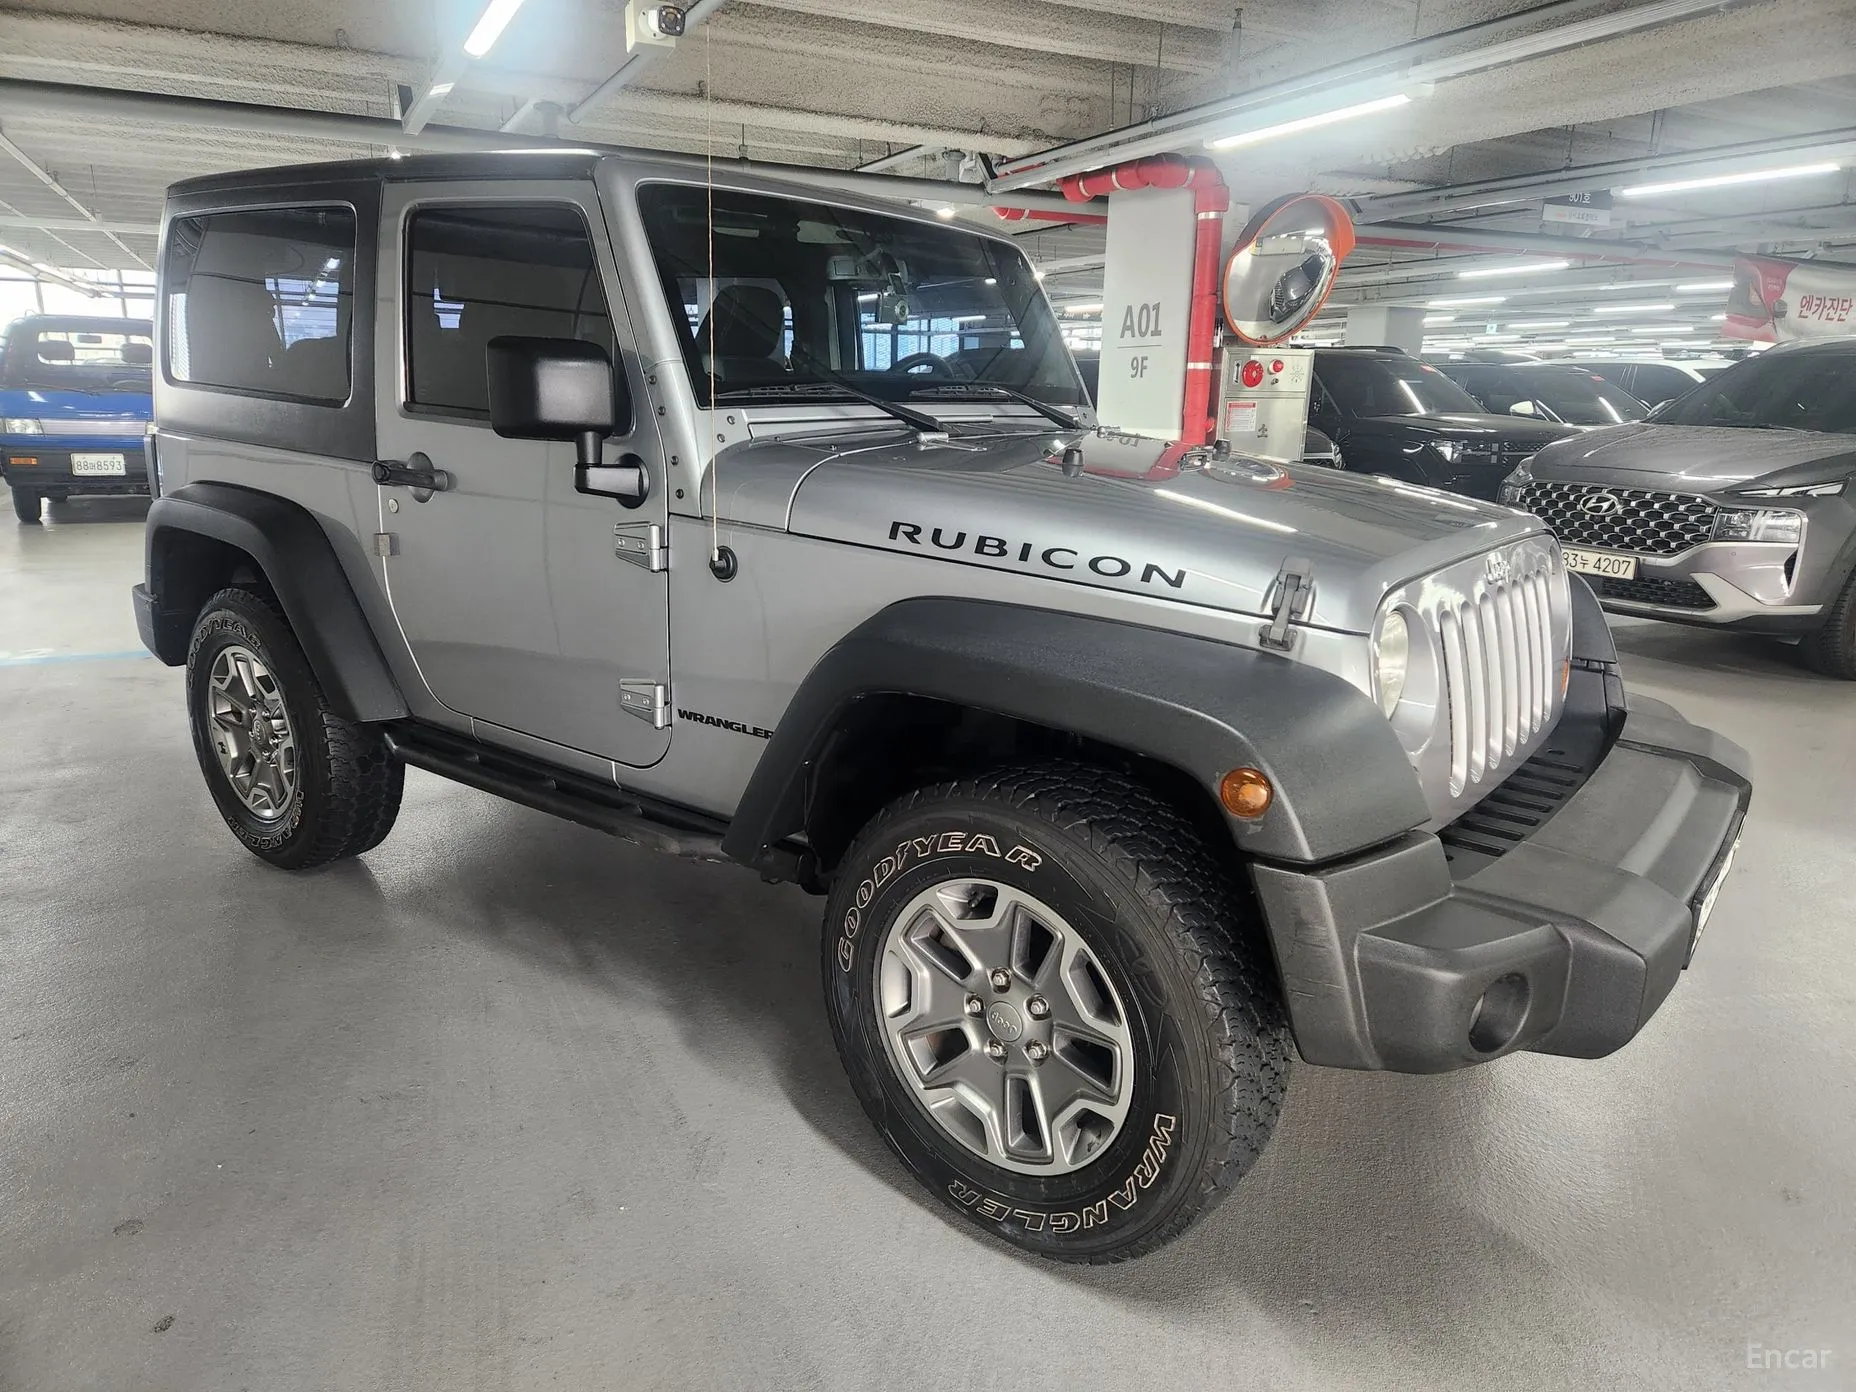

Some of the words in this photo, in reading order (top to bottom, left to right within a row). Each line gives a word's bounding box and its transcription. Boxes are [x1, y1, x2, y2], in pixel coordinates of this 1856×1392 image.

[1119, 301, 1162, 339] A01
[1798, 294, 1854, 322] 엔카진단
[1130, 356, 1148, 378] 9F
[888, 520, 1187, 589] RUBICON
[1593, 557, 1631, 575] 4207
[837, 830, 1043, 974] GOODYEAR
[948, 1112, 1177, 1234] WRANGLER
